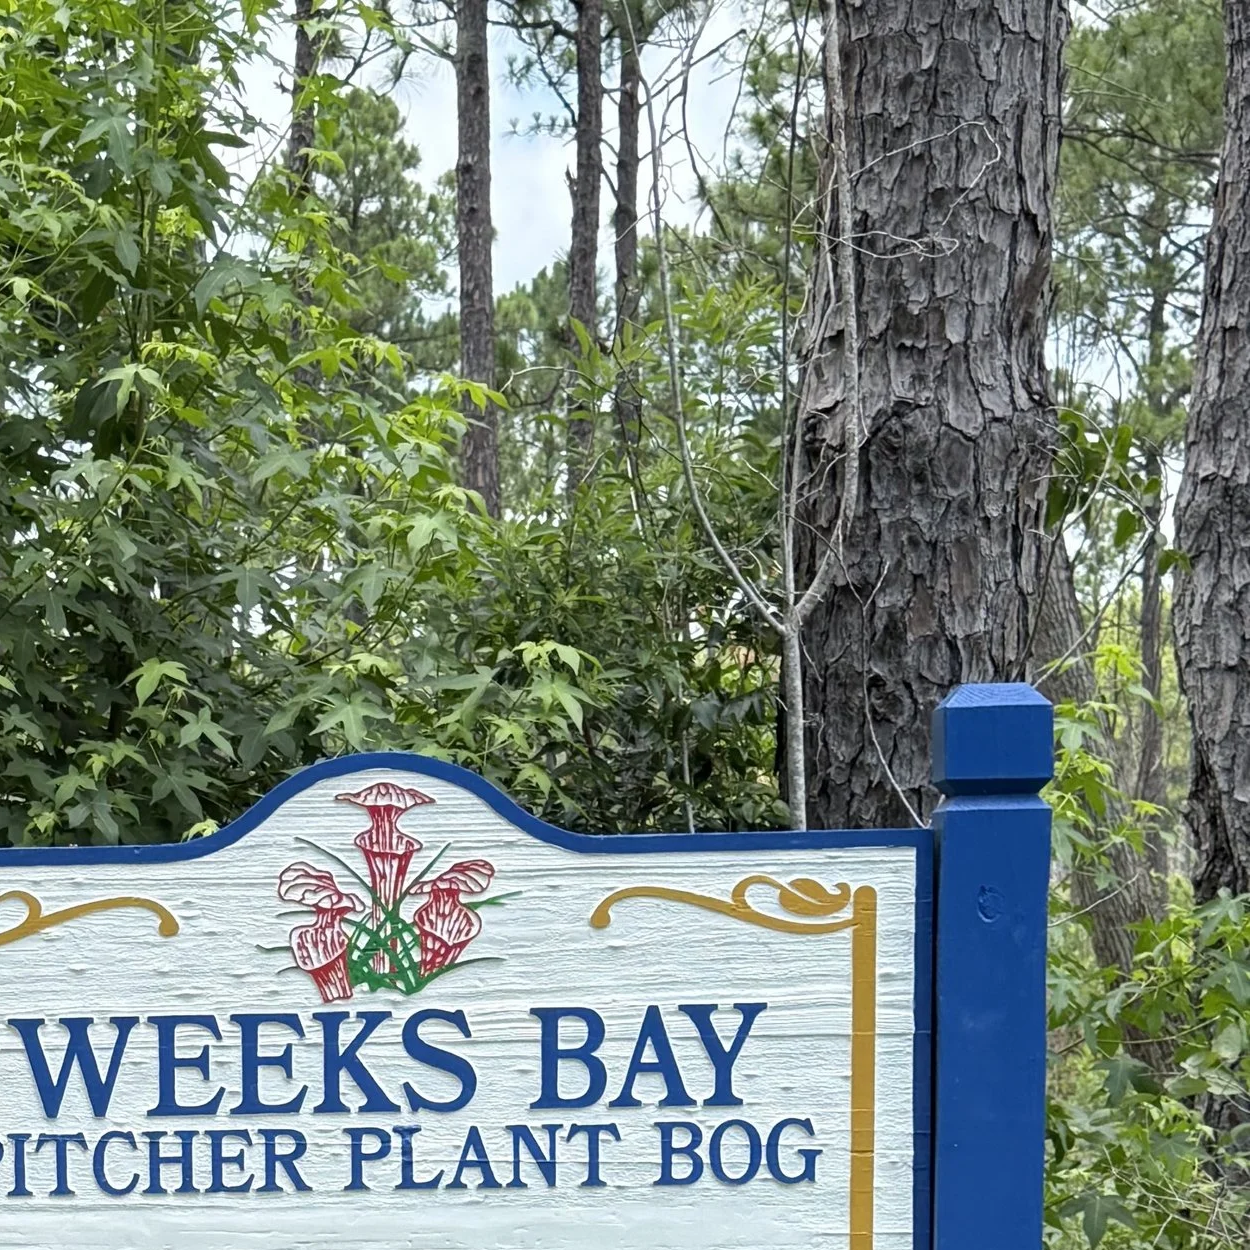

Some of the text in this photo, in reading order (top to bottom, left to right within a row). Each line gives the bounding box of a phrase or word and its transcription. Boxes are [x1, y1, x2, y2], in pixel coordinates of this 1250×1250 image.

[8, 1002, 768, 1120] WEEKS BAY
[345, 1123, 622, 1191] PLANT
[655, 1118, 823, 1187] BOG
